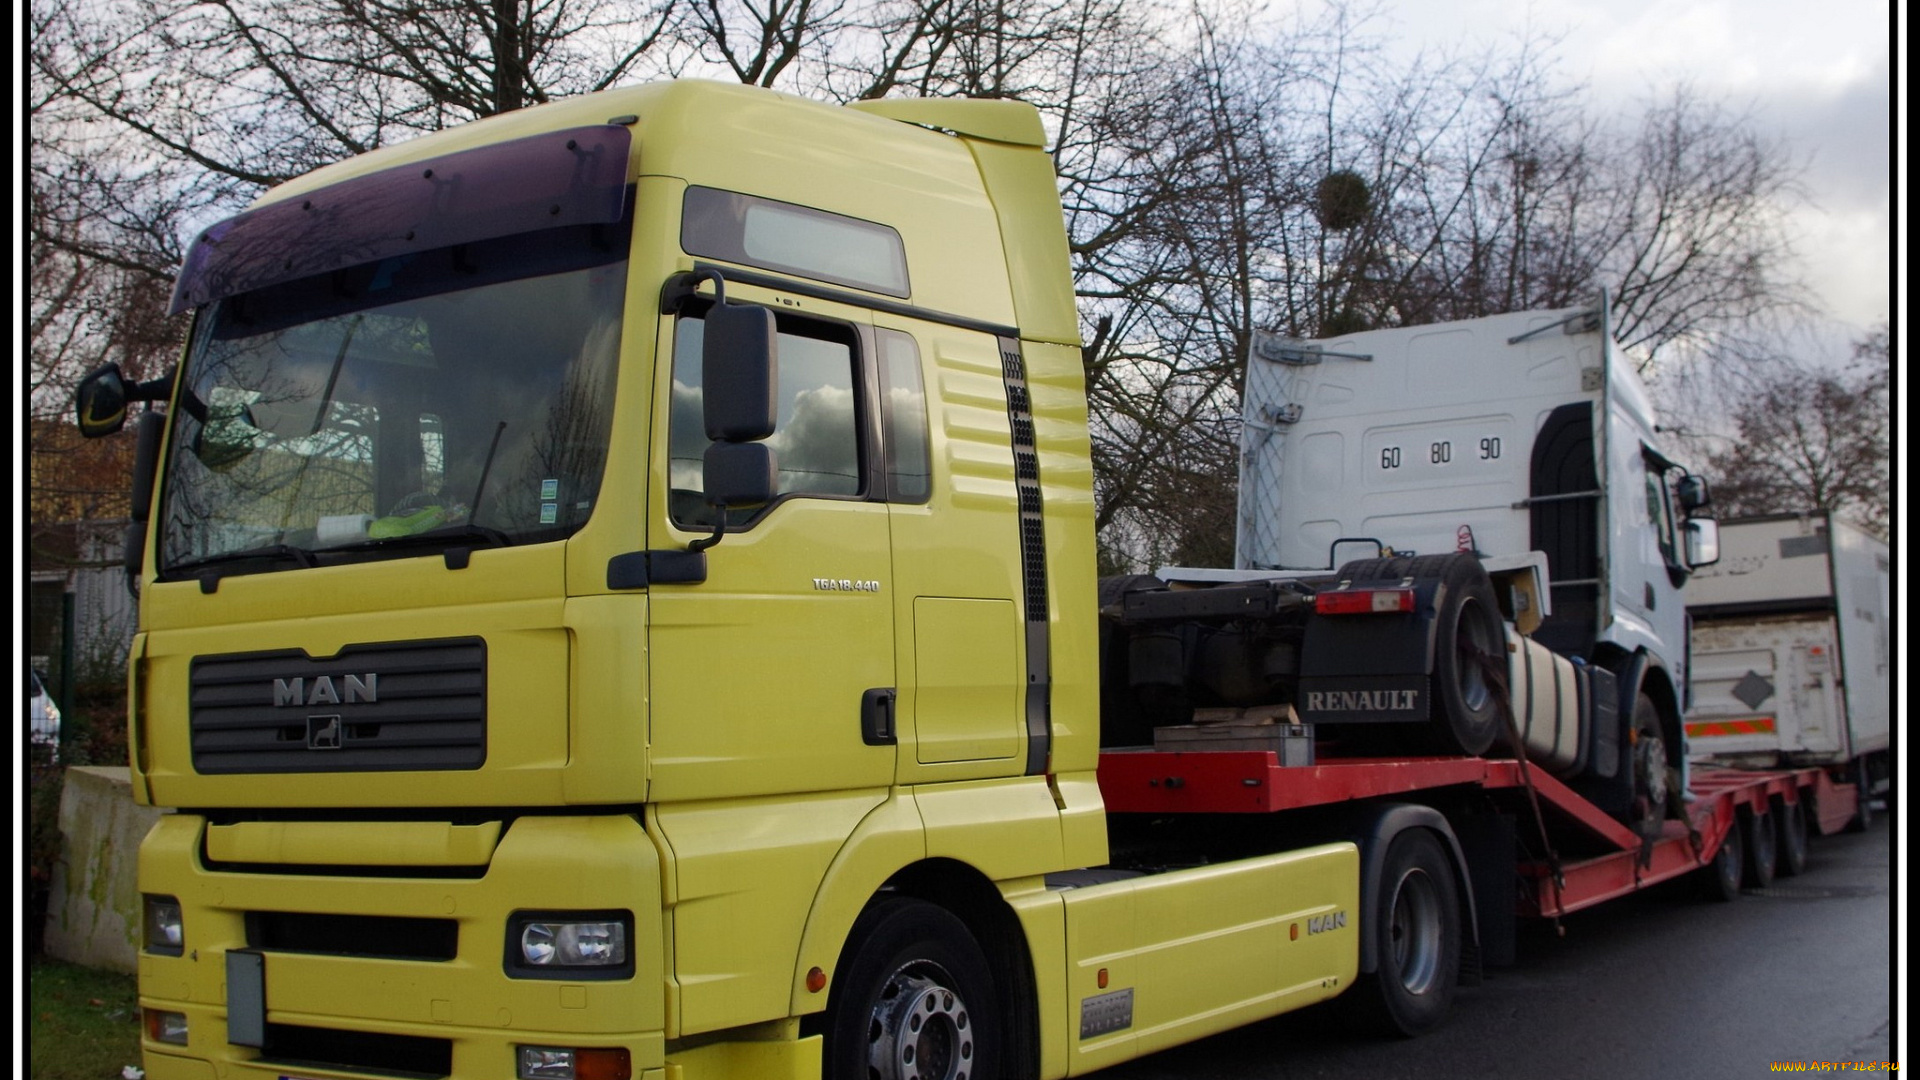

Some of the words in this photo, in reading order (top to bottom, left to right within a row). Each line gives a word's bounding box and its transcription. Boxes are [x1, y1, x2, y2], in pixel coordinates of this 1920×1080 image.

[1381, 446, 1401, 469] 60
[1431, 441, 1451, 464] 80
[1480, 437, 1500, 460] 90
[273, 673, 377, 706] MAN
[1306, 689, 1419, 711] RENAULT
[1307, 910, 1347, 935] MAN
